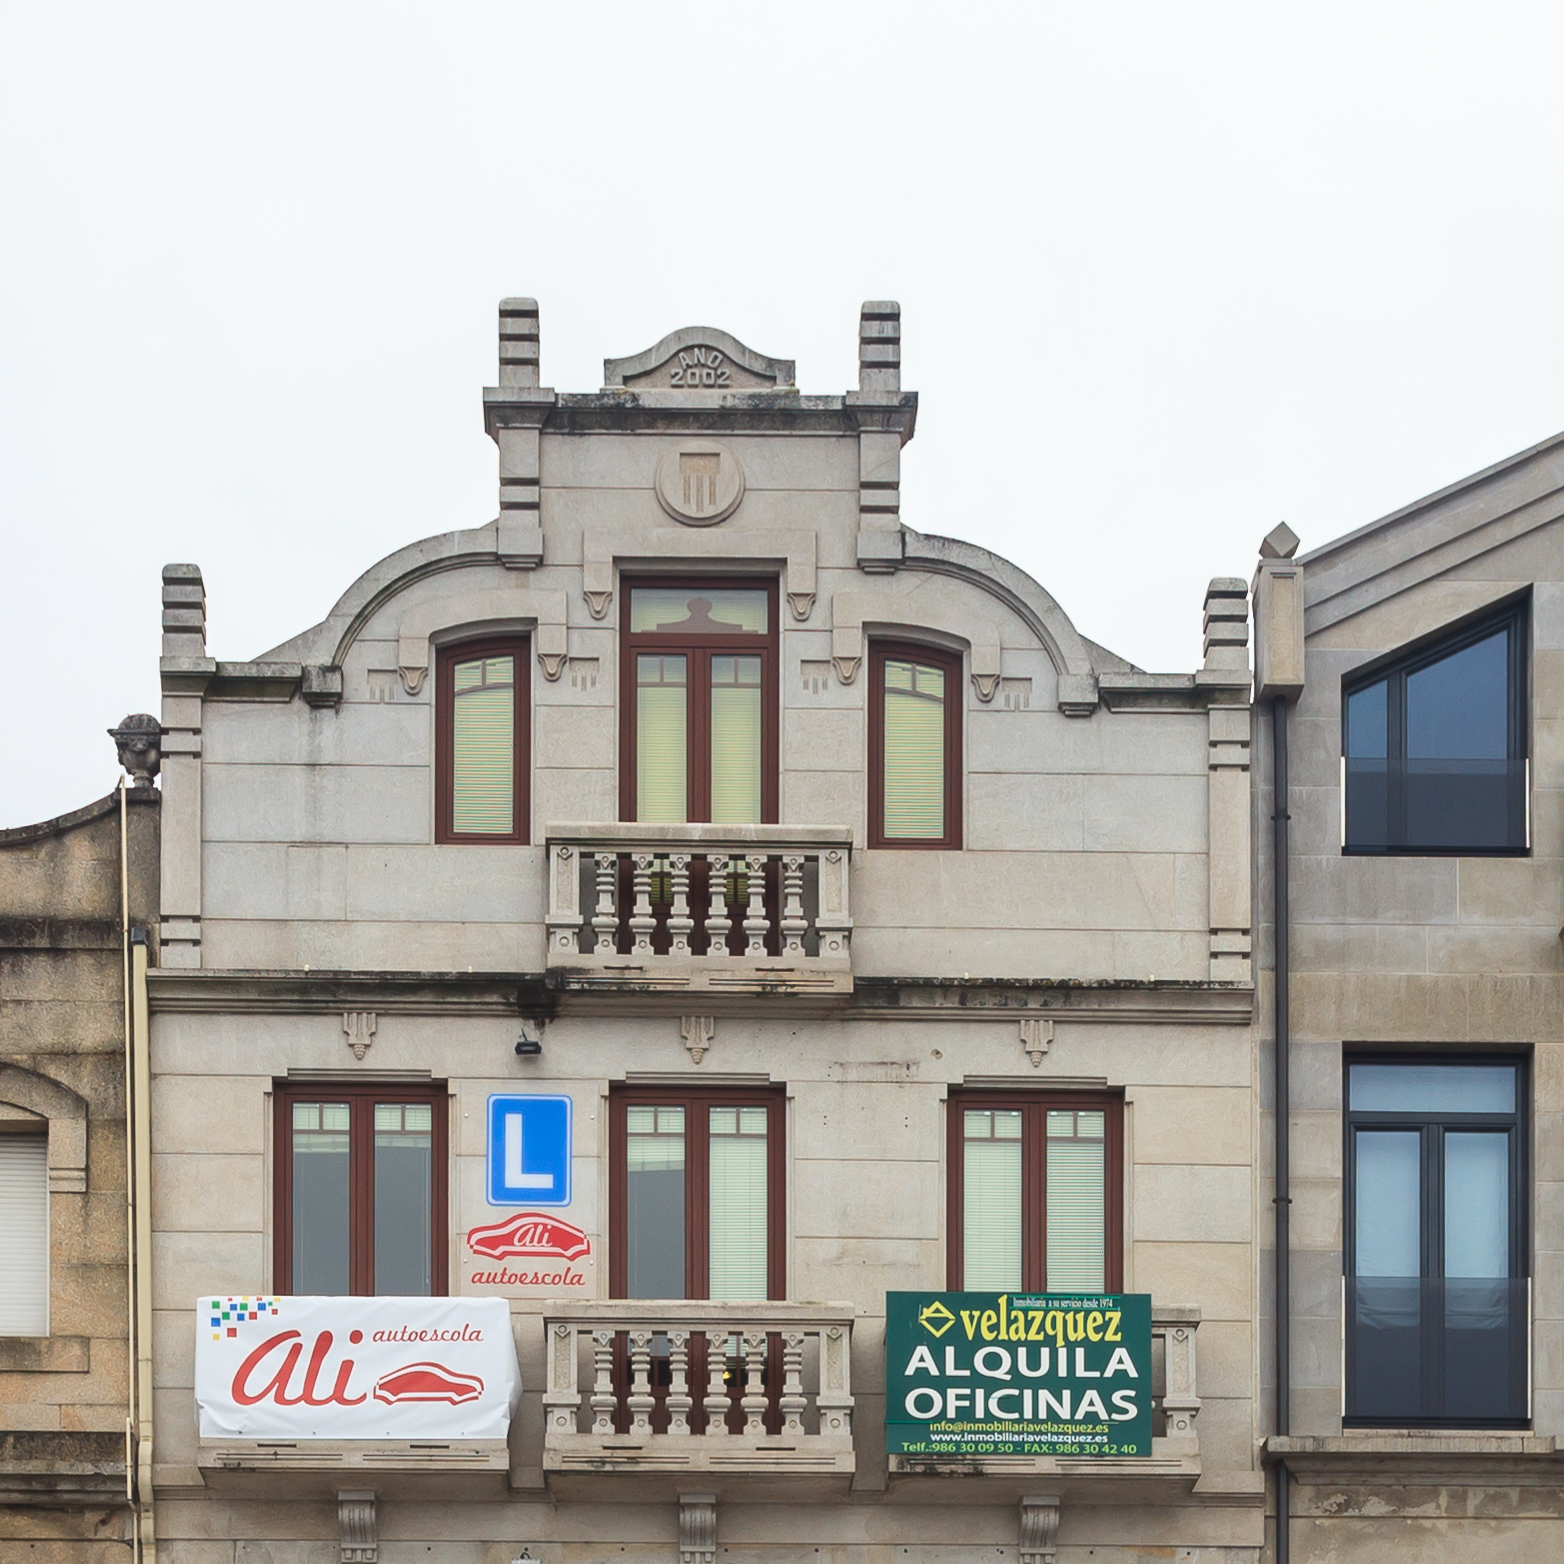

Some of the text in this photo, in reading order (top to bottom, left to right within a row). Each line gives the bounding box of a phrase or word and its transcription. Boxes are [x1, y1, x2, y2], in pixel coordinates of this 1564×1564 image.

[671, 369, 731, 387] 2002
[505, 1113, 554, 1189] L
[471, 1267, 586, 1286] autoescola
[960, 1295, 1121, 1347] velazquez
[372, 1324, 484, 1344] autoescola
[904, 1346, 1139, 1381] ALQUILA
[905, 1387, 1138, 1421] OFICINAS
[930, 1421, 1108, 1434] info@inmobiliariavelazquez.es
[930, 1432, 1108, 1444] www.inmobiliariavelazquez.es
